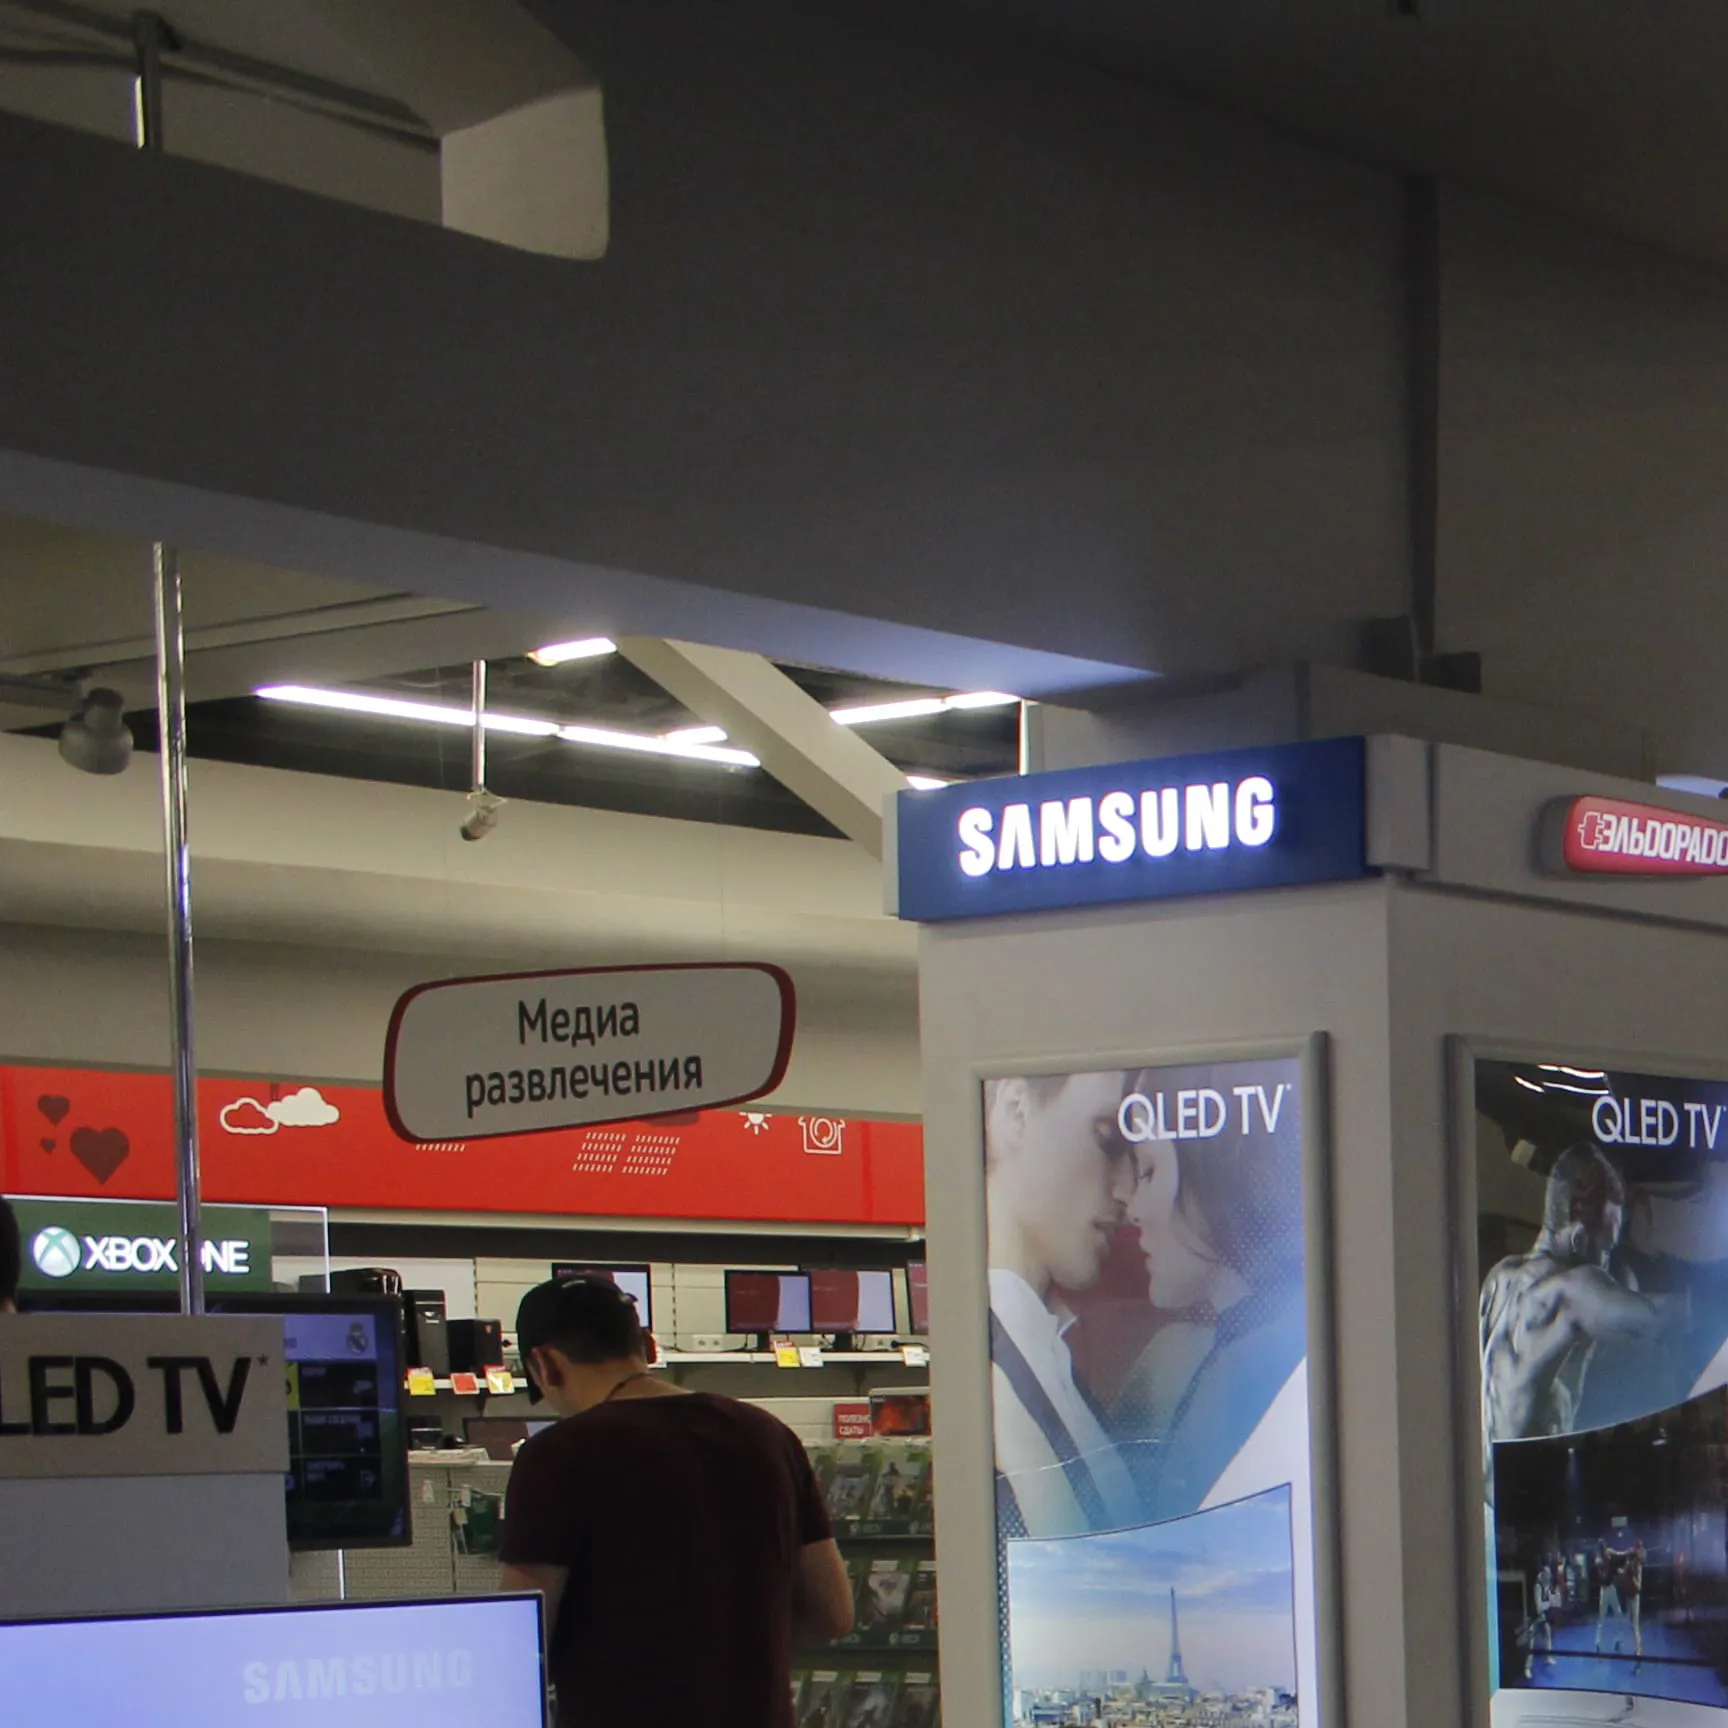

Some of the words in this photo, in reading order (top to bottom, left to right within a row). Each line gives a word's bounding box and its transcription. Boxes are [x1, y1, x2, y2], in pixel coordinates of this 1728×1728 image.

[958, 776, 1277, 877] SAMSUNG
[518, 1000, 640, 1047] Медиа
[465, 1053, 704, 1116] развлечения
[1117, 1089, 1226, 1143] QLED
[1593, 1095, 1678, 1146] QLED
[85, 1236, 178, 1273] XBOX
[199, 1239, 250, 1274] NE
[243, 1648, 475, 1705] SAMSUNG
